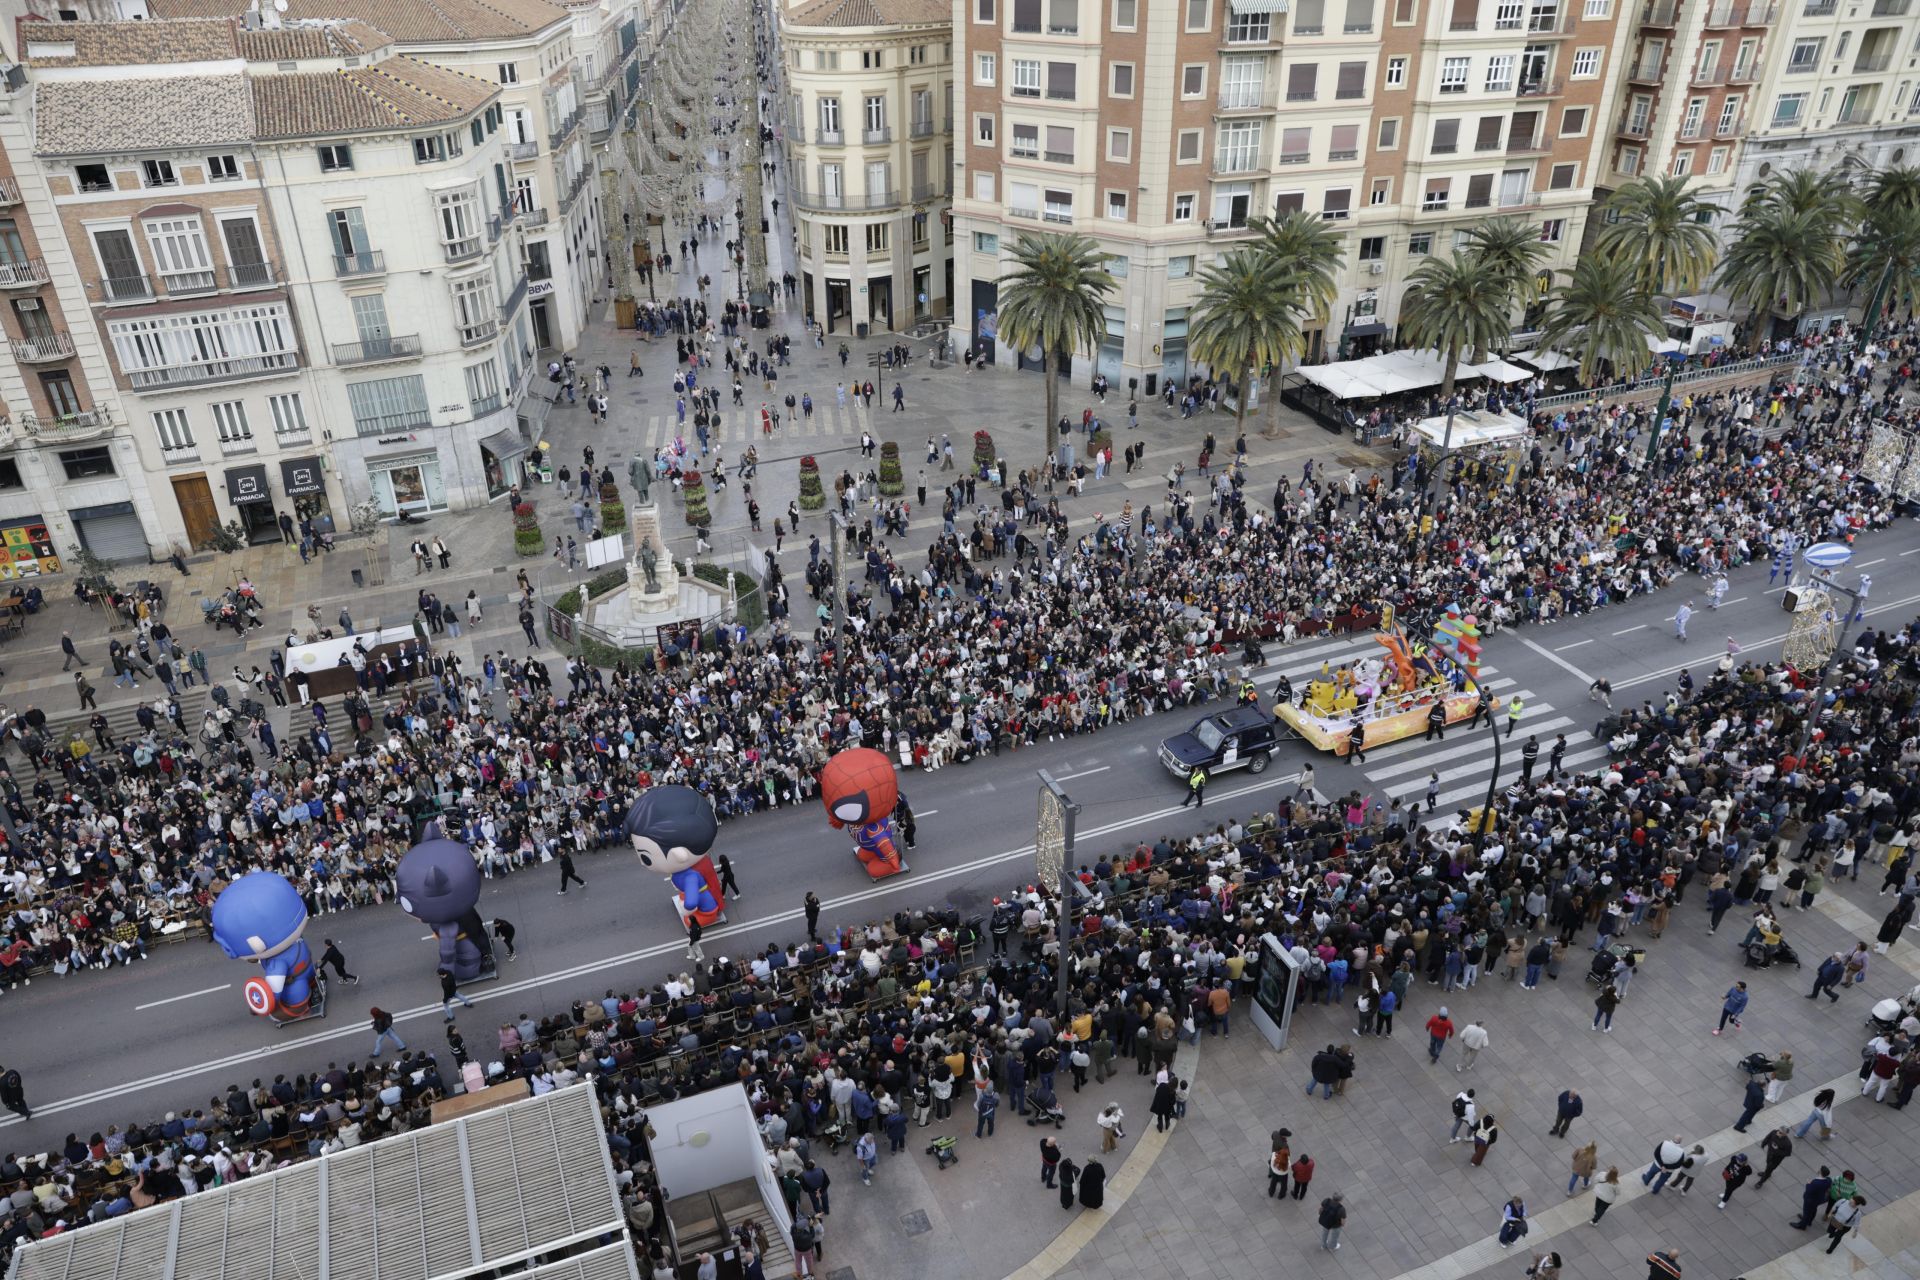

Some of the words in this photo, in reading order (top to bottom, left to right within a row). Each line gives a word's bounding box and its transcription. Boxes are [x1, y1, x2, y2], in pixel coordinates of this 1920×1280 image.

[528, 281, 553, 295] BBVA
[378, 435, 408, 445] helvetia
[288, 485, 320, 494] FARMACIA
[233, 493, 266, 503] FARMACIA
